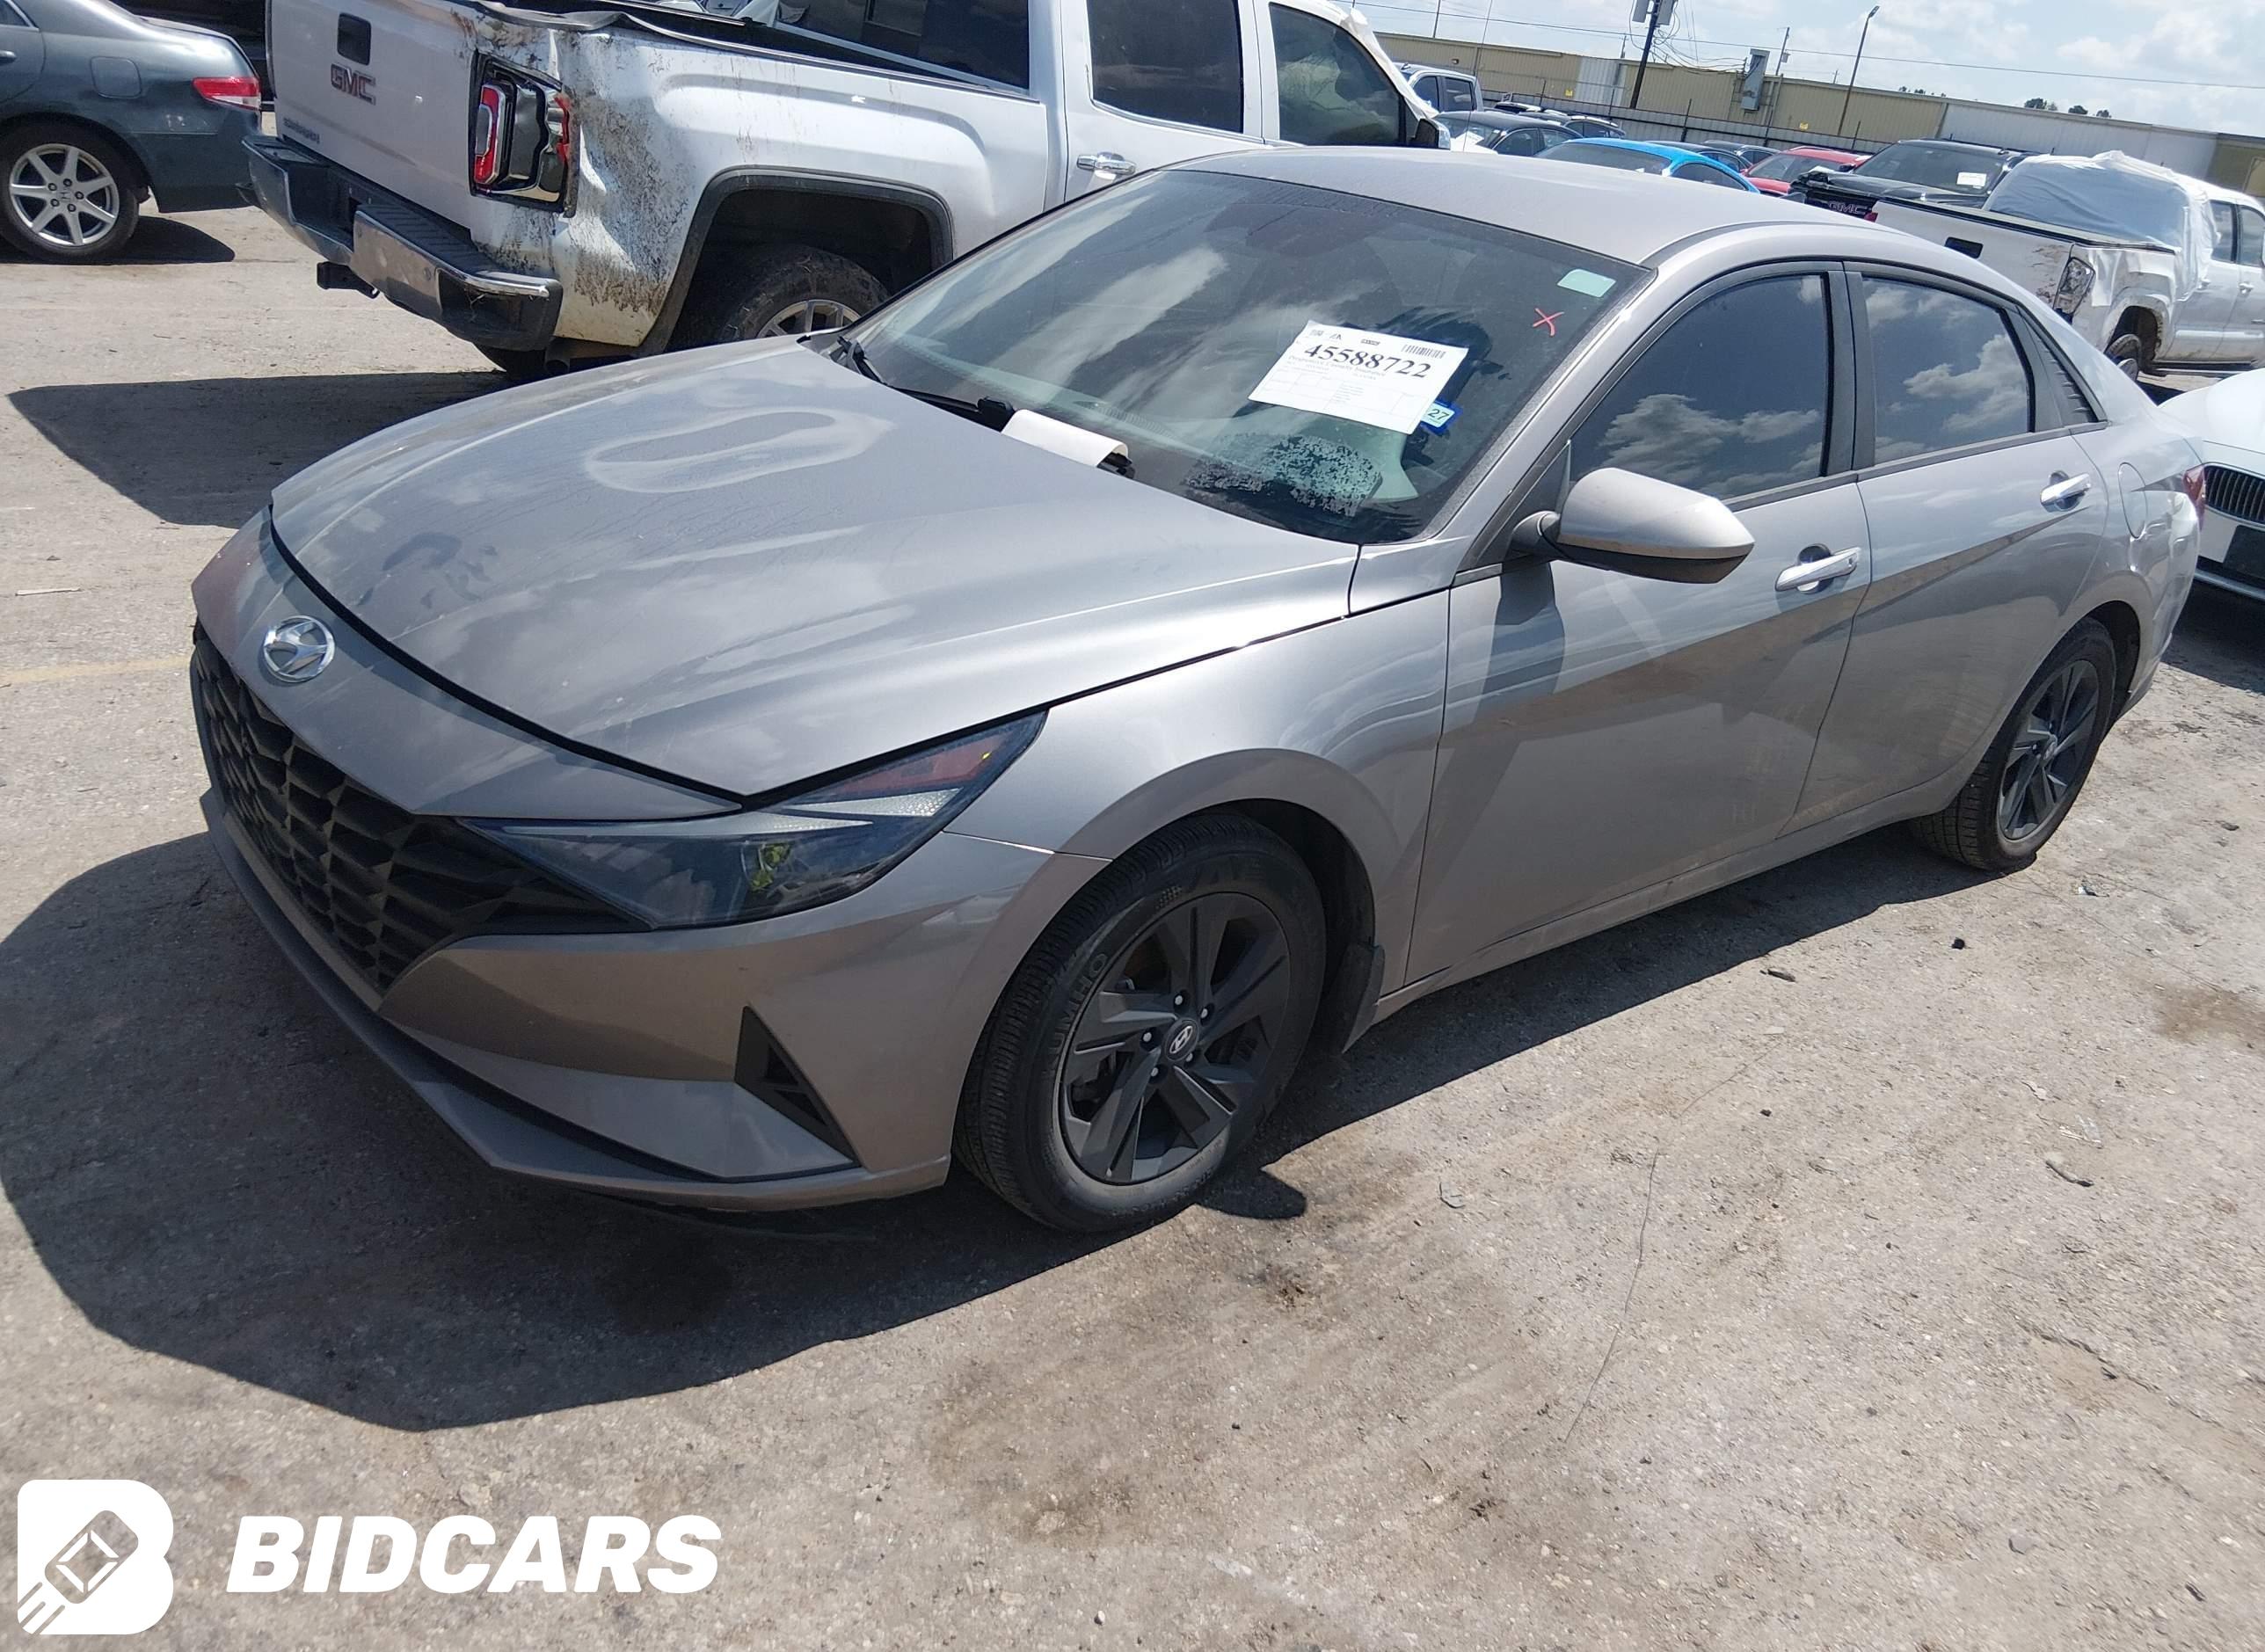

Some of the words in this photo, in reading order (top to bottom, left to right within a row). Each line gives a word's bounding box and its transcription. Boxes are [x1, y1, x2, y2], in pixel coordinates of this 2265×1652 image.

[331, 63, 376, 106] GMC
[1829, 201, 1868, 215] GMC
[1303, 344, 1431, 378] 45588722
[1427, 408, 1450, 420] 27
